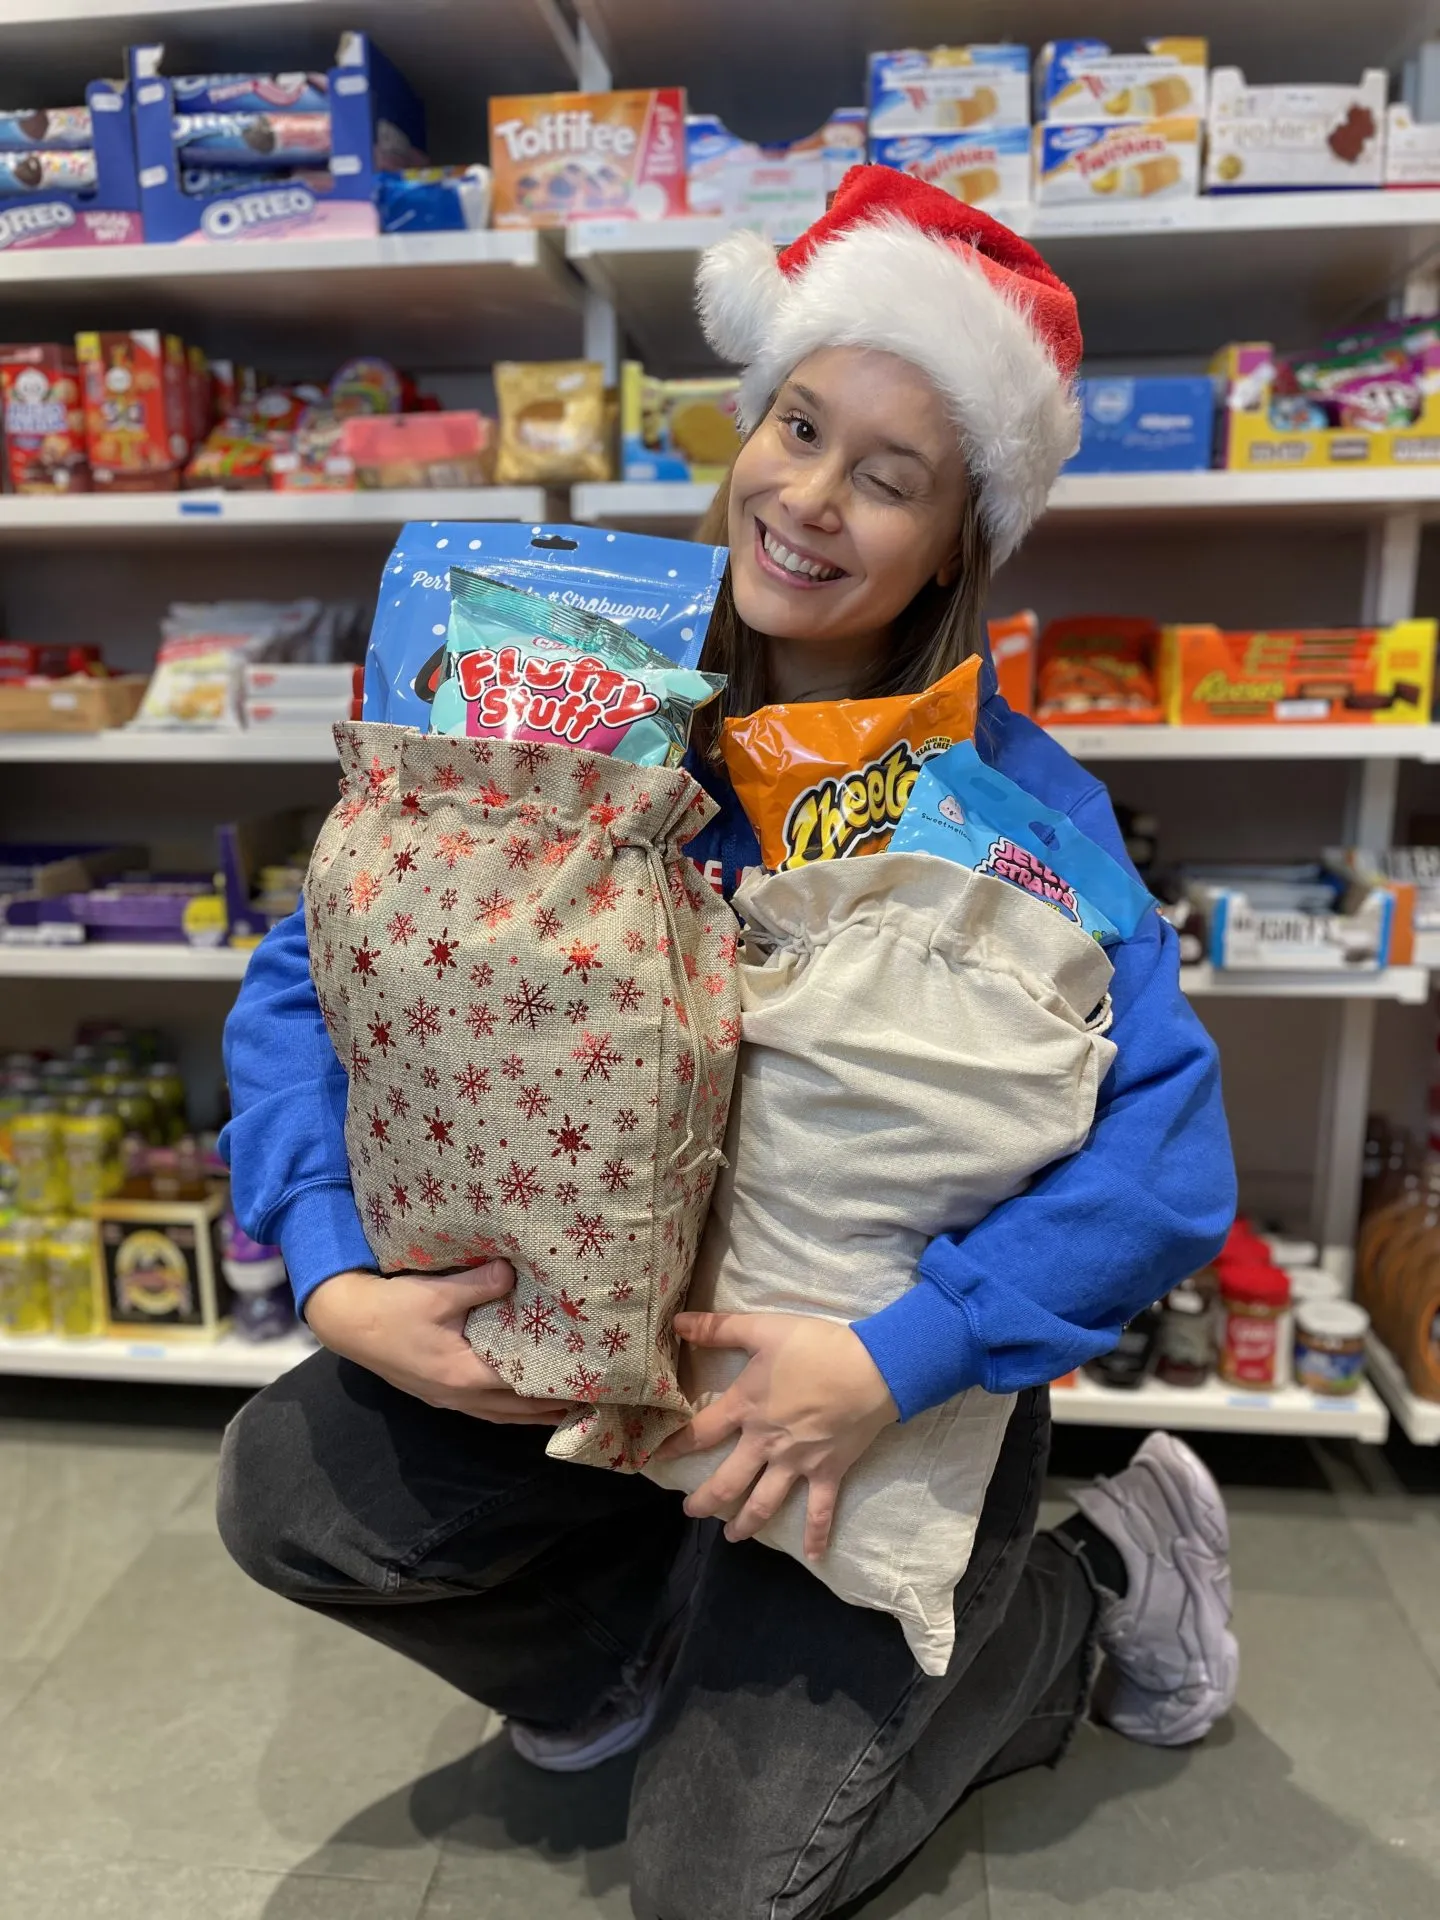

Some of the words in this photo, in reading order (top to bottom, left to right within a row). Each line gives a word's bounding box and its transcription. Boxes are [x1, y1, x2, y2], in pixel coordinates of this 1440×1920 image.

[494, 110, 637, 162] Toffifee
[207, 186, 315, 235] OREO
[457, 647, 661, 729] Fluffy
[479, 686, 605, 744] Stuff
[915, 745, 931, 757] REAL
[785, 746, 920, 869] Cheeto
[994, 859, 1074, 909] STRAWS
